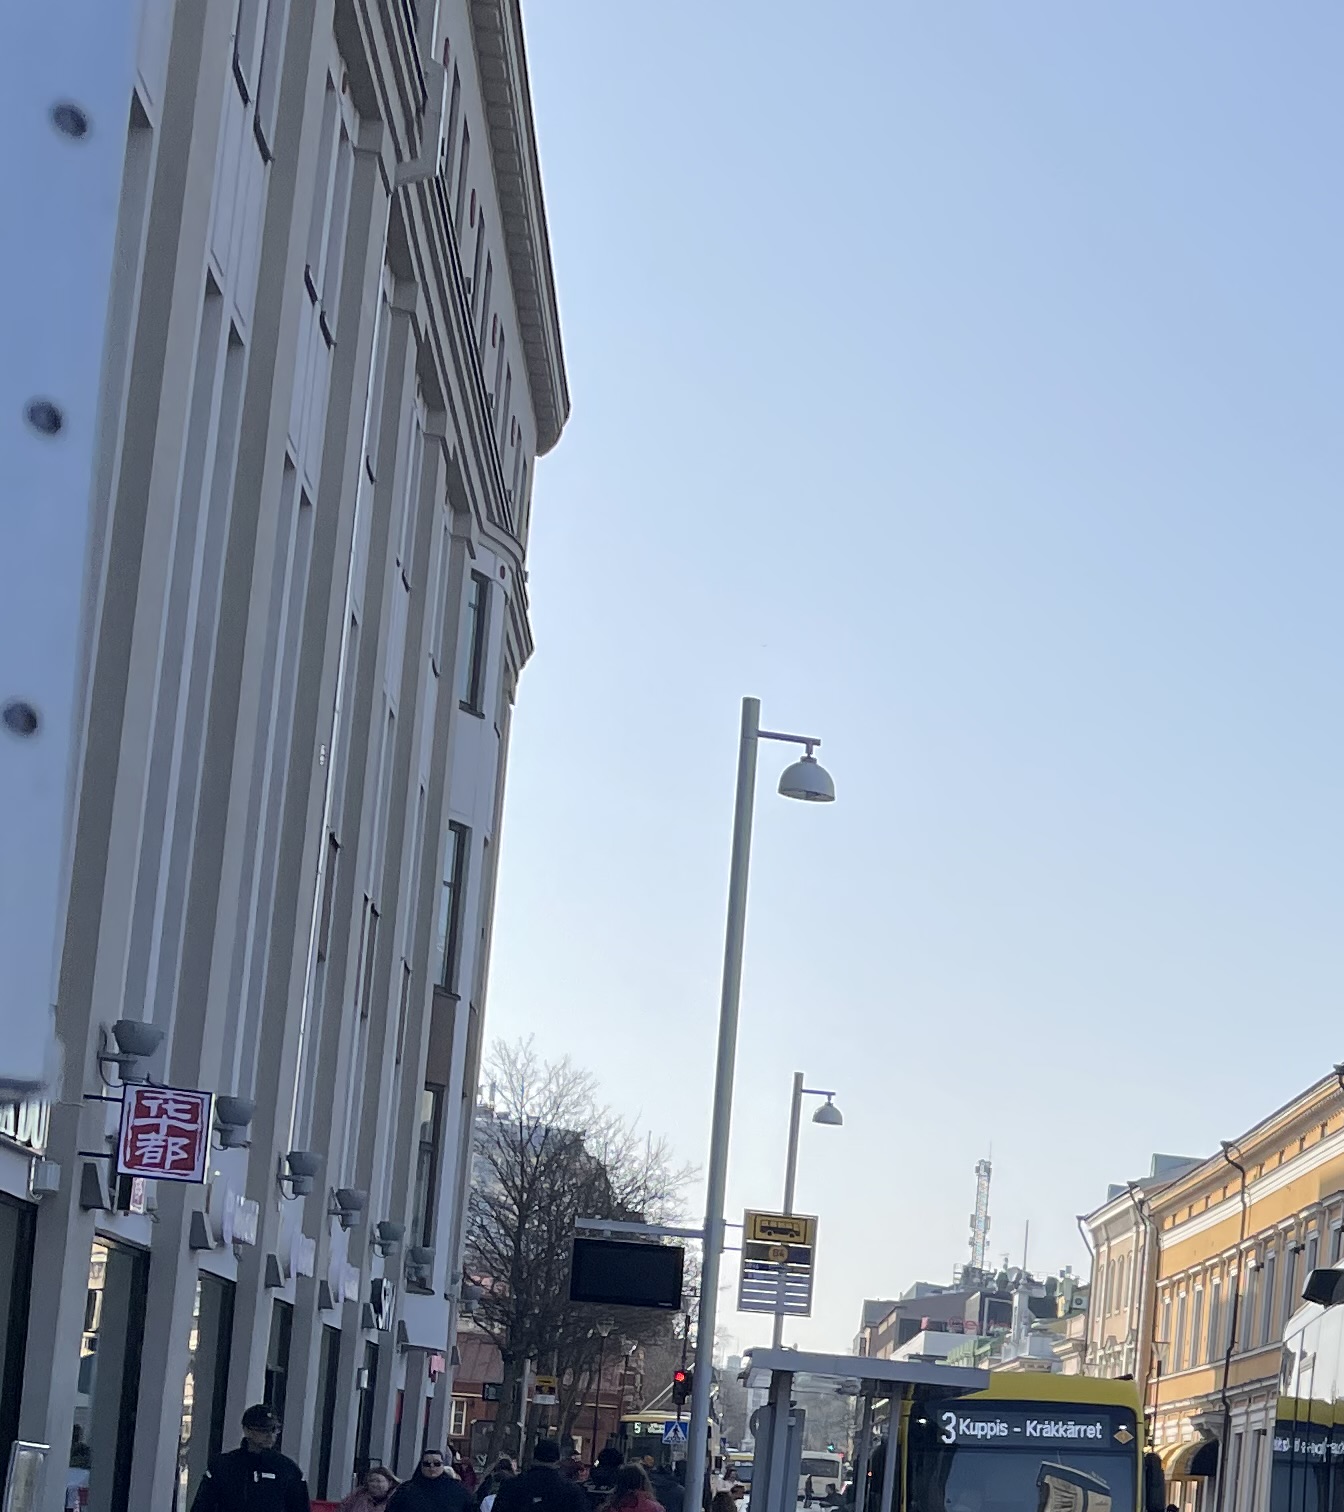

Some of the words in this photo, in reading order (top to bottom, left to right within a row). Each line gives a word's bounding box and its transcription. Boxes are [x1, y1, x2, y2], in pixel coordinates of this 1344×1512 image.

[633, 1421, 643, 1434] 5
[941, 1411, 957, 1444] 3
[959, 1418, 1009, 1440] Kuppis
